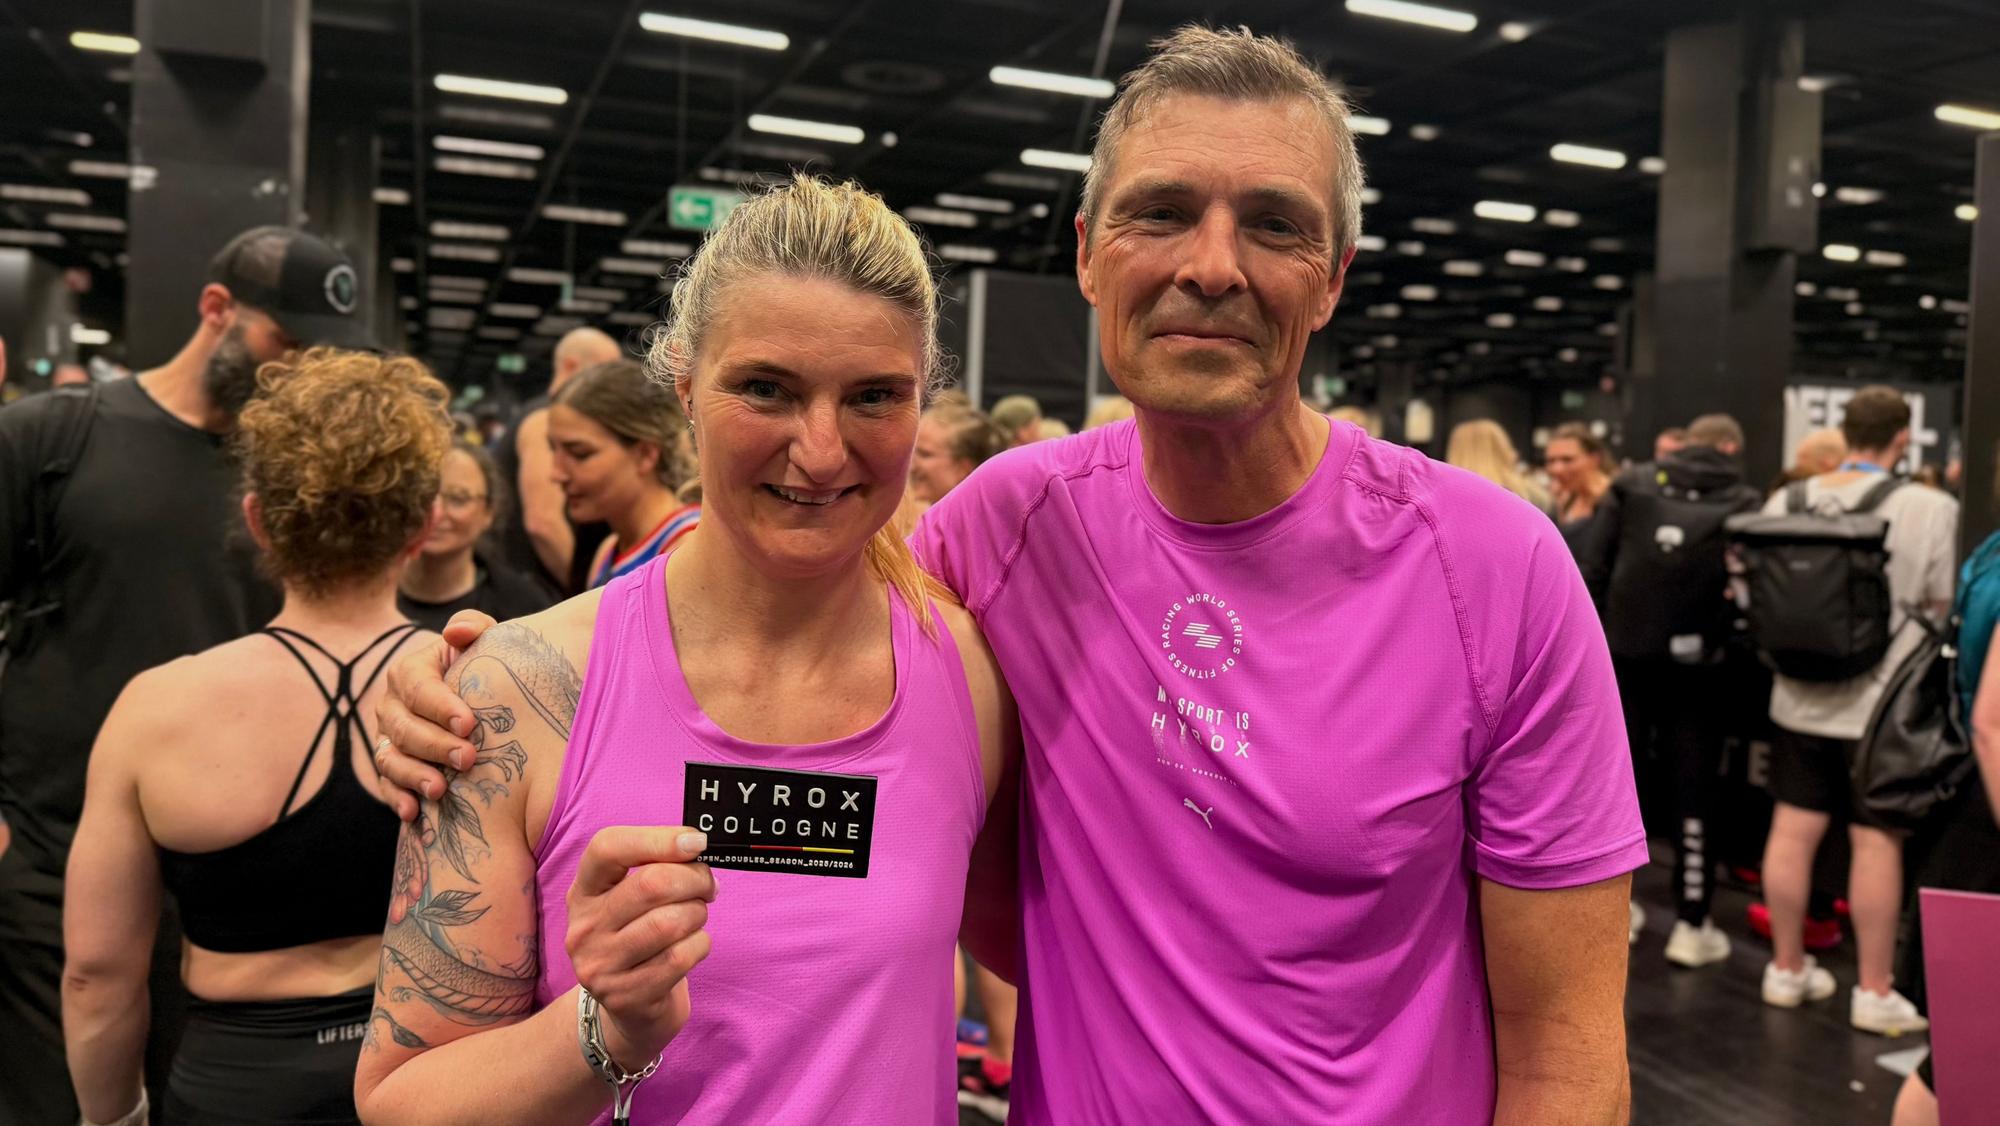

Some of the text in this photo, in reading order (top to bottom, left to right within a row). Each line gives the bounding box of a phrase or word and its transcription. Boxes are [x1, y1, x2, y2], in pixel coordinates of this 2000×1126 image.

[1161, 593, 1244, 679] WORLD SERIES OF FITNESS RACING
[1157, 685, 1249, 731] M SPORT IS
[1151, 711, 1250, 759] HYROX
[700, 778, 860, 812] HYROX
[698, 813, 860, 840] COLOGNE
